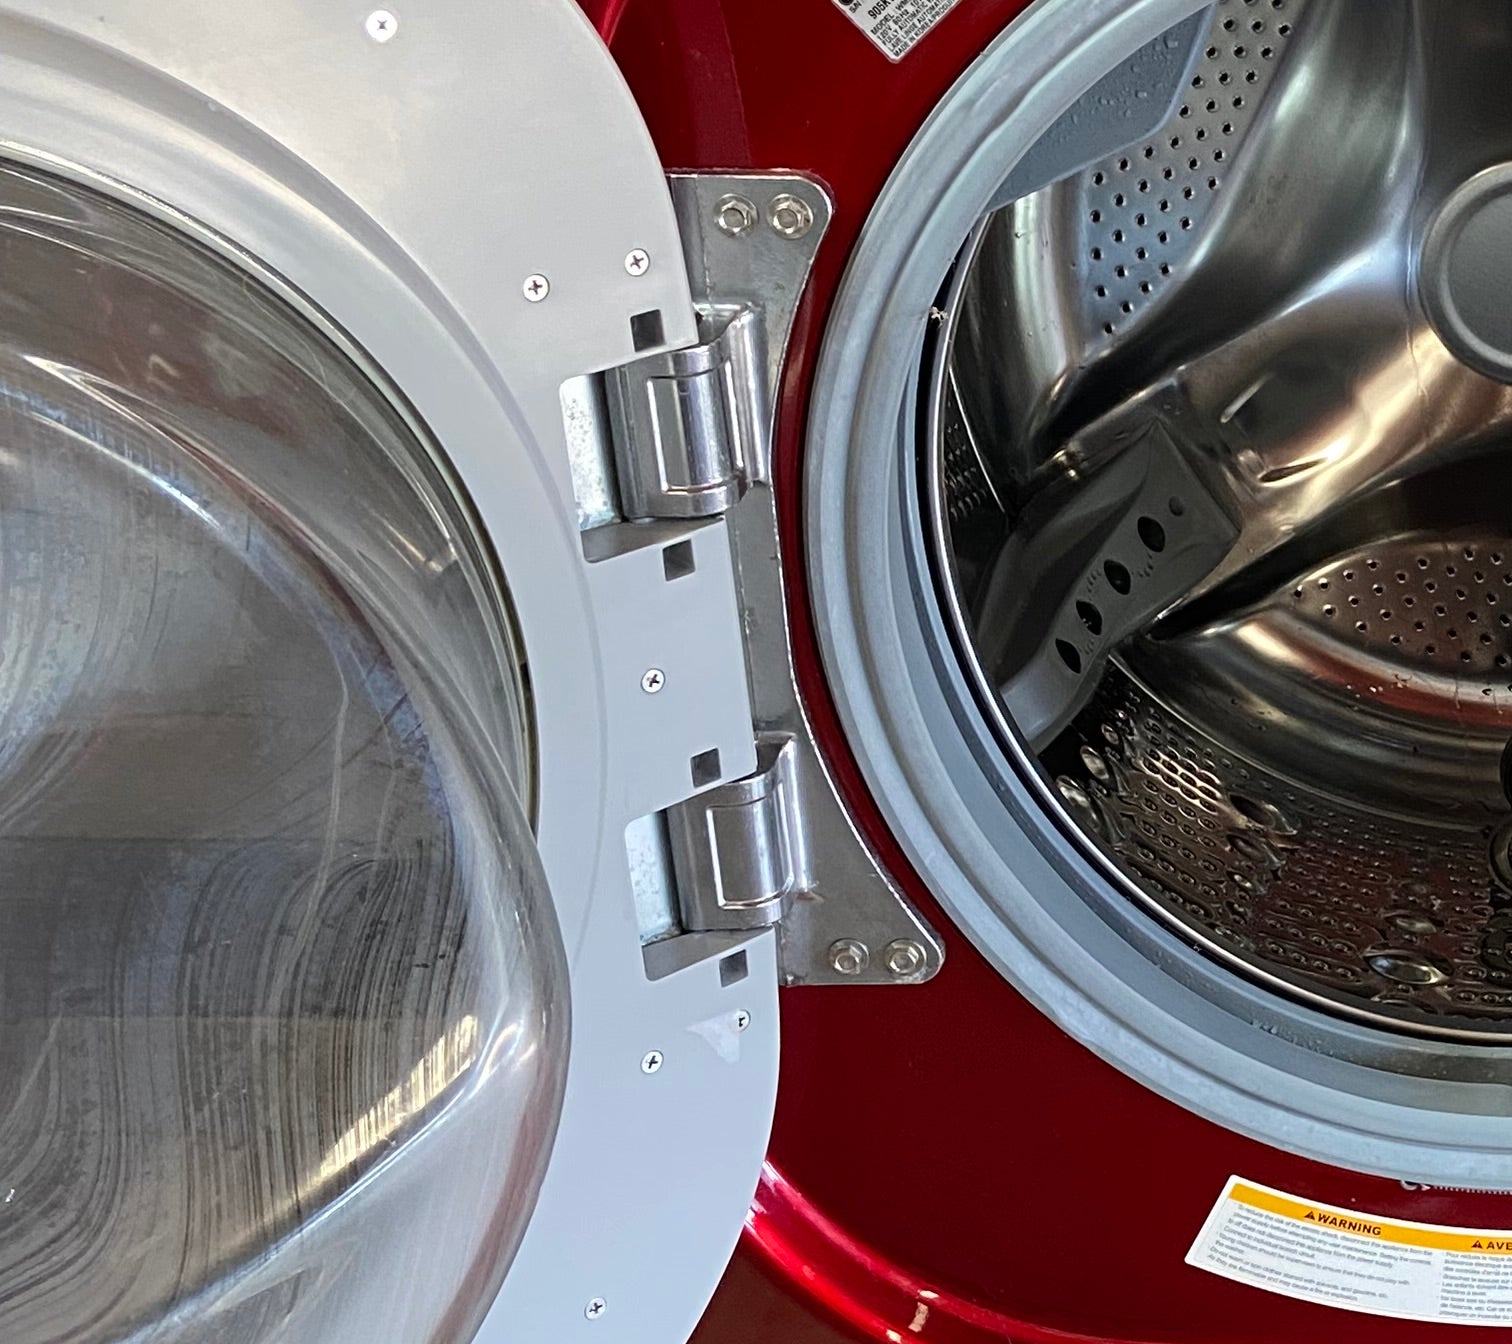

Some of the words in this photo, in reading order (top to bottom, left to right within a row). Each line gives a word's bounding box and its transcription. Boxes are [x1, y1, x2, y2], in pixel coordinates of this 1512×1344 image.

[869, 12, 895, 35] MODEL
[876, 23, 892, 41] 120V
[881, 28, 899, 46] FULLY
[897, 1, 928, 31] AUTOMATIC
[887, 36, 903, 52] LAVE
[900, 21, 918, 39] LINGE
[892, 40, 910, 57] MADE
[908, 34, 916, 43] IN
[1317, 1213, 1381, 1236] WARNING
